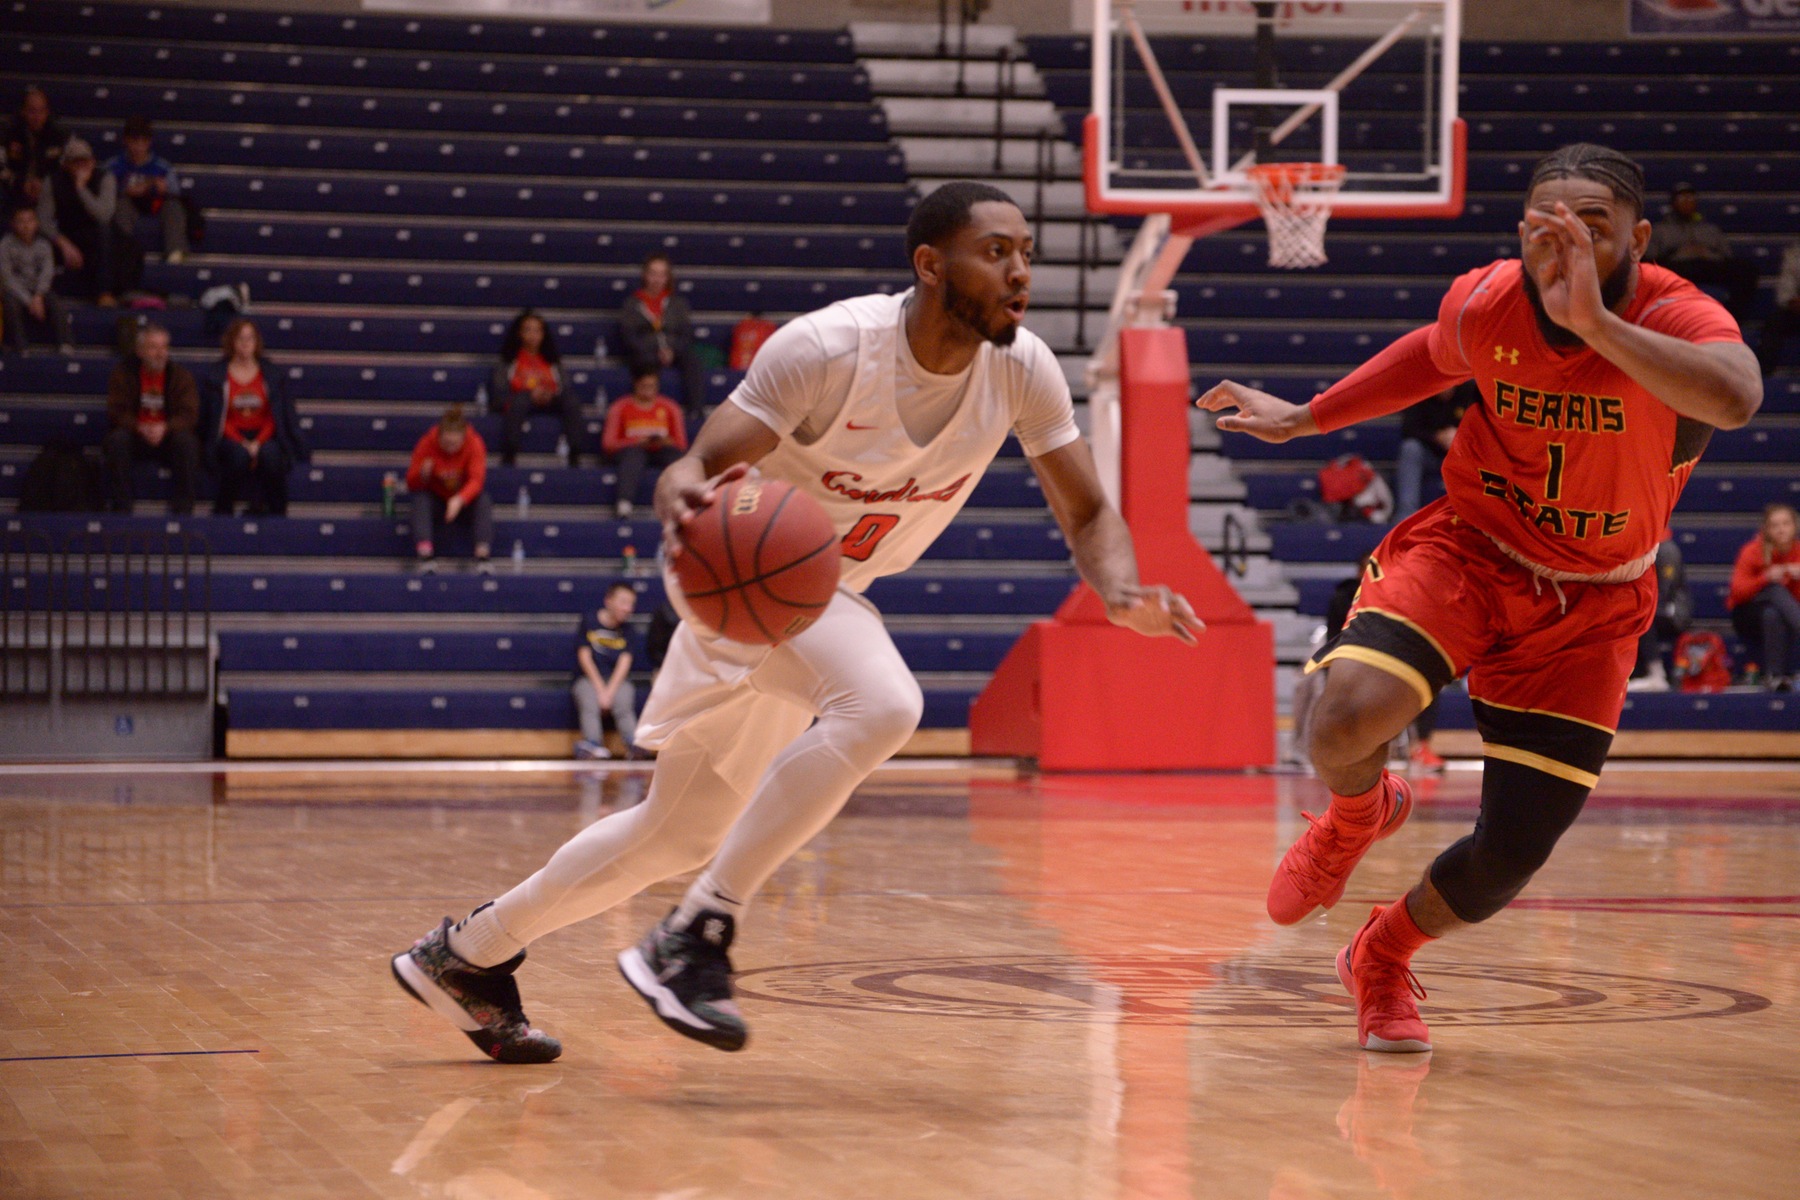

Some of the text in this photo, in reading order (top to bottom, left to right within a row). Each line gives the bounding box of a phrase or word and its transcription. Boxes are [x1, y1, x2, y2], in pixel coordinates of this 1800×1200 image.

[1494, 379, 1626, 434] FERRIS
[1544, 441, 1565, 501] 1
[1478, 468, 1631, 540] STATE
[840, 513, 900, 562] 0
